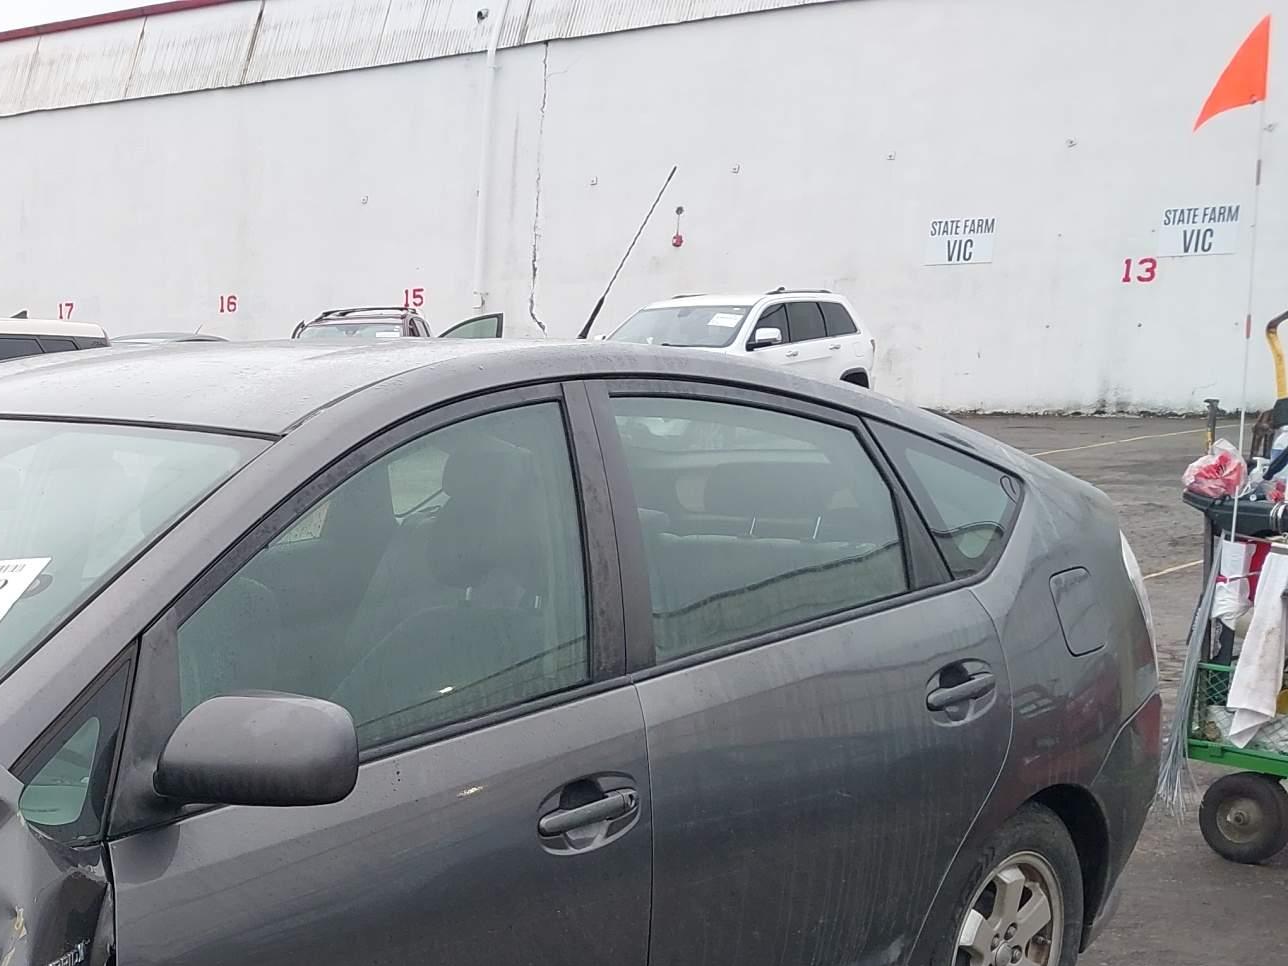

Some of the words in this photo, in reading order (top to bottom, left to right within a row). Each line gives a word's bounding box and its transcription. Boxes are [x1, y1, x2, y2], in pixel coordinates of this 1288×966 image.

[1164, 208, 1199, 226] STATE
[1202, 205, 1240, 223] FARM
[930, 219, 960, 236] STATE
[963, 218, 995, 234] FARM
[947, 238, 973, 262] VIC
[1183, 228, 1214, 254] VIC
[1121, 257, 1157, 283] 13
[218, 295, 238, 313] 16
[404, 288, 424, 307] 15
[59, 302, 74, 320] 17
